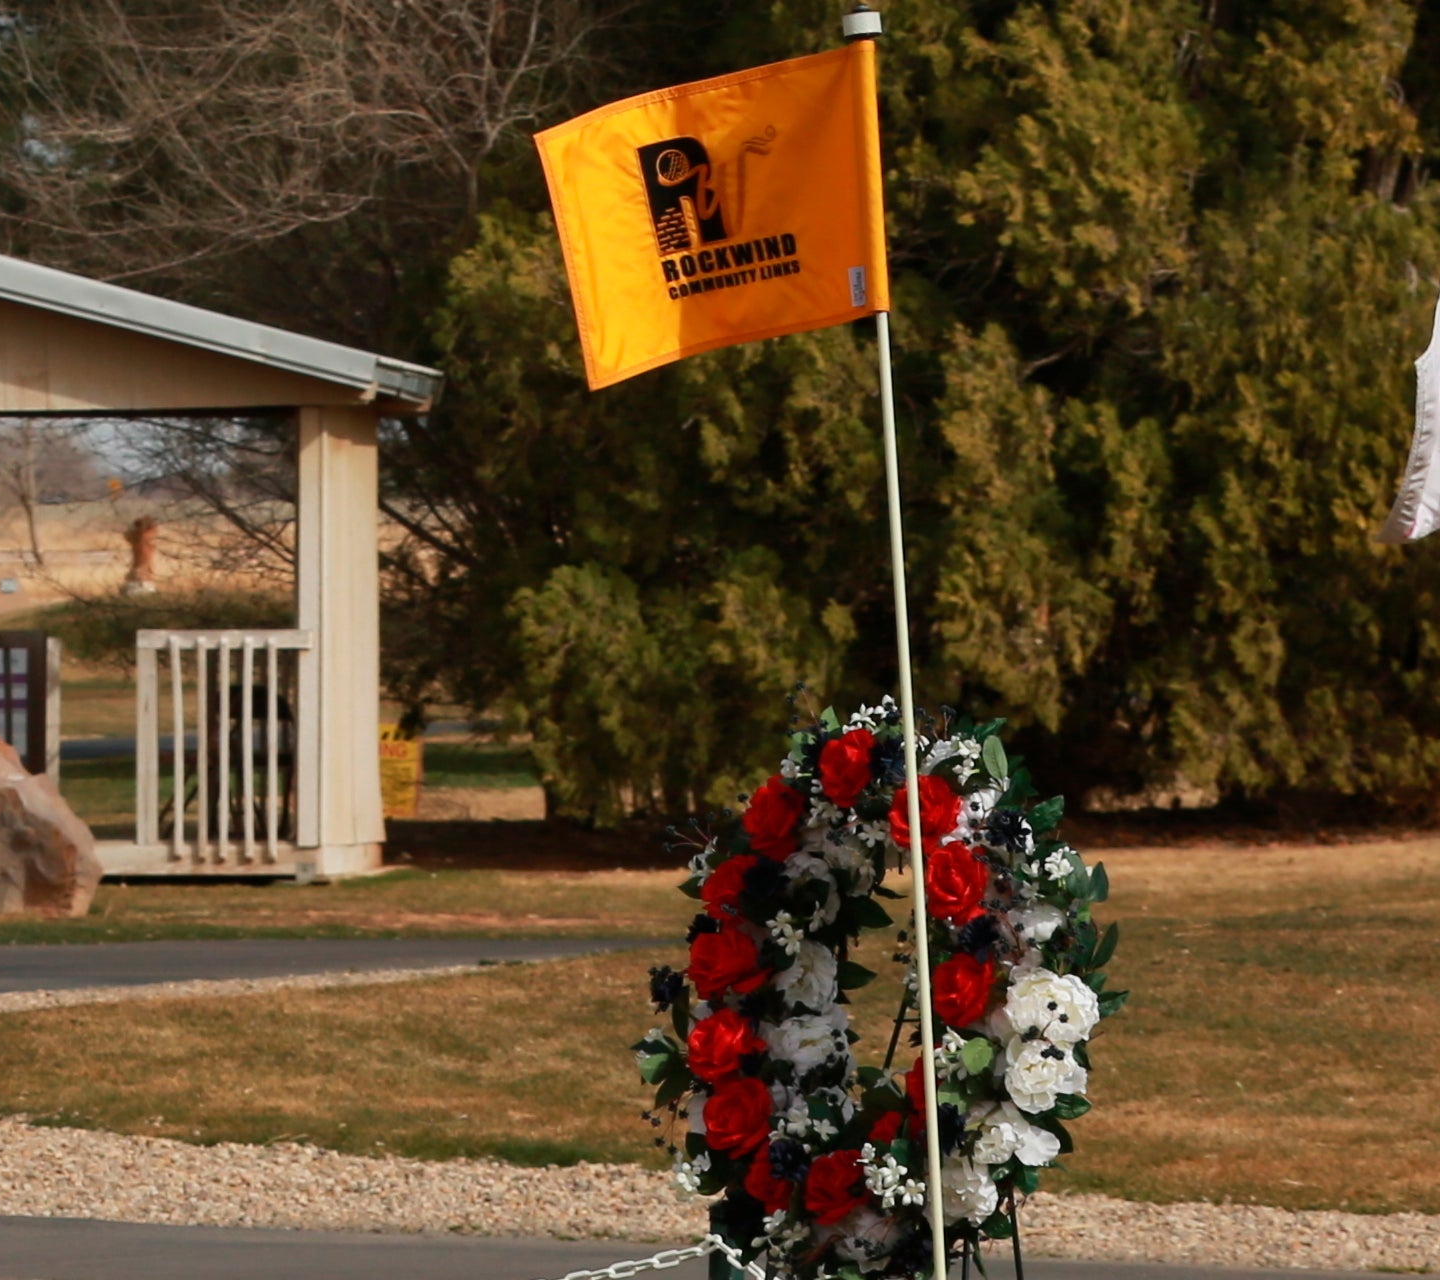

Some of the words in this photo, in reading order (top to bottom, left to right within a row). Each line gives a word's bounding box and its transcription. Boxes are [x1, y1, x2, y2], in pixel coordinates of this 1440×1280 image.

[661, 233, 797, 283] ROCKWIND
[668, 268, 757, 300] COMMUNITY
[760, 260, 801, 281] LINKS
